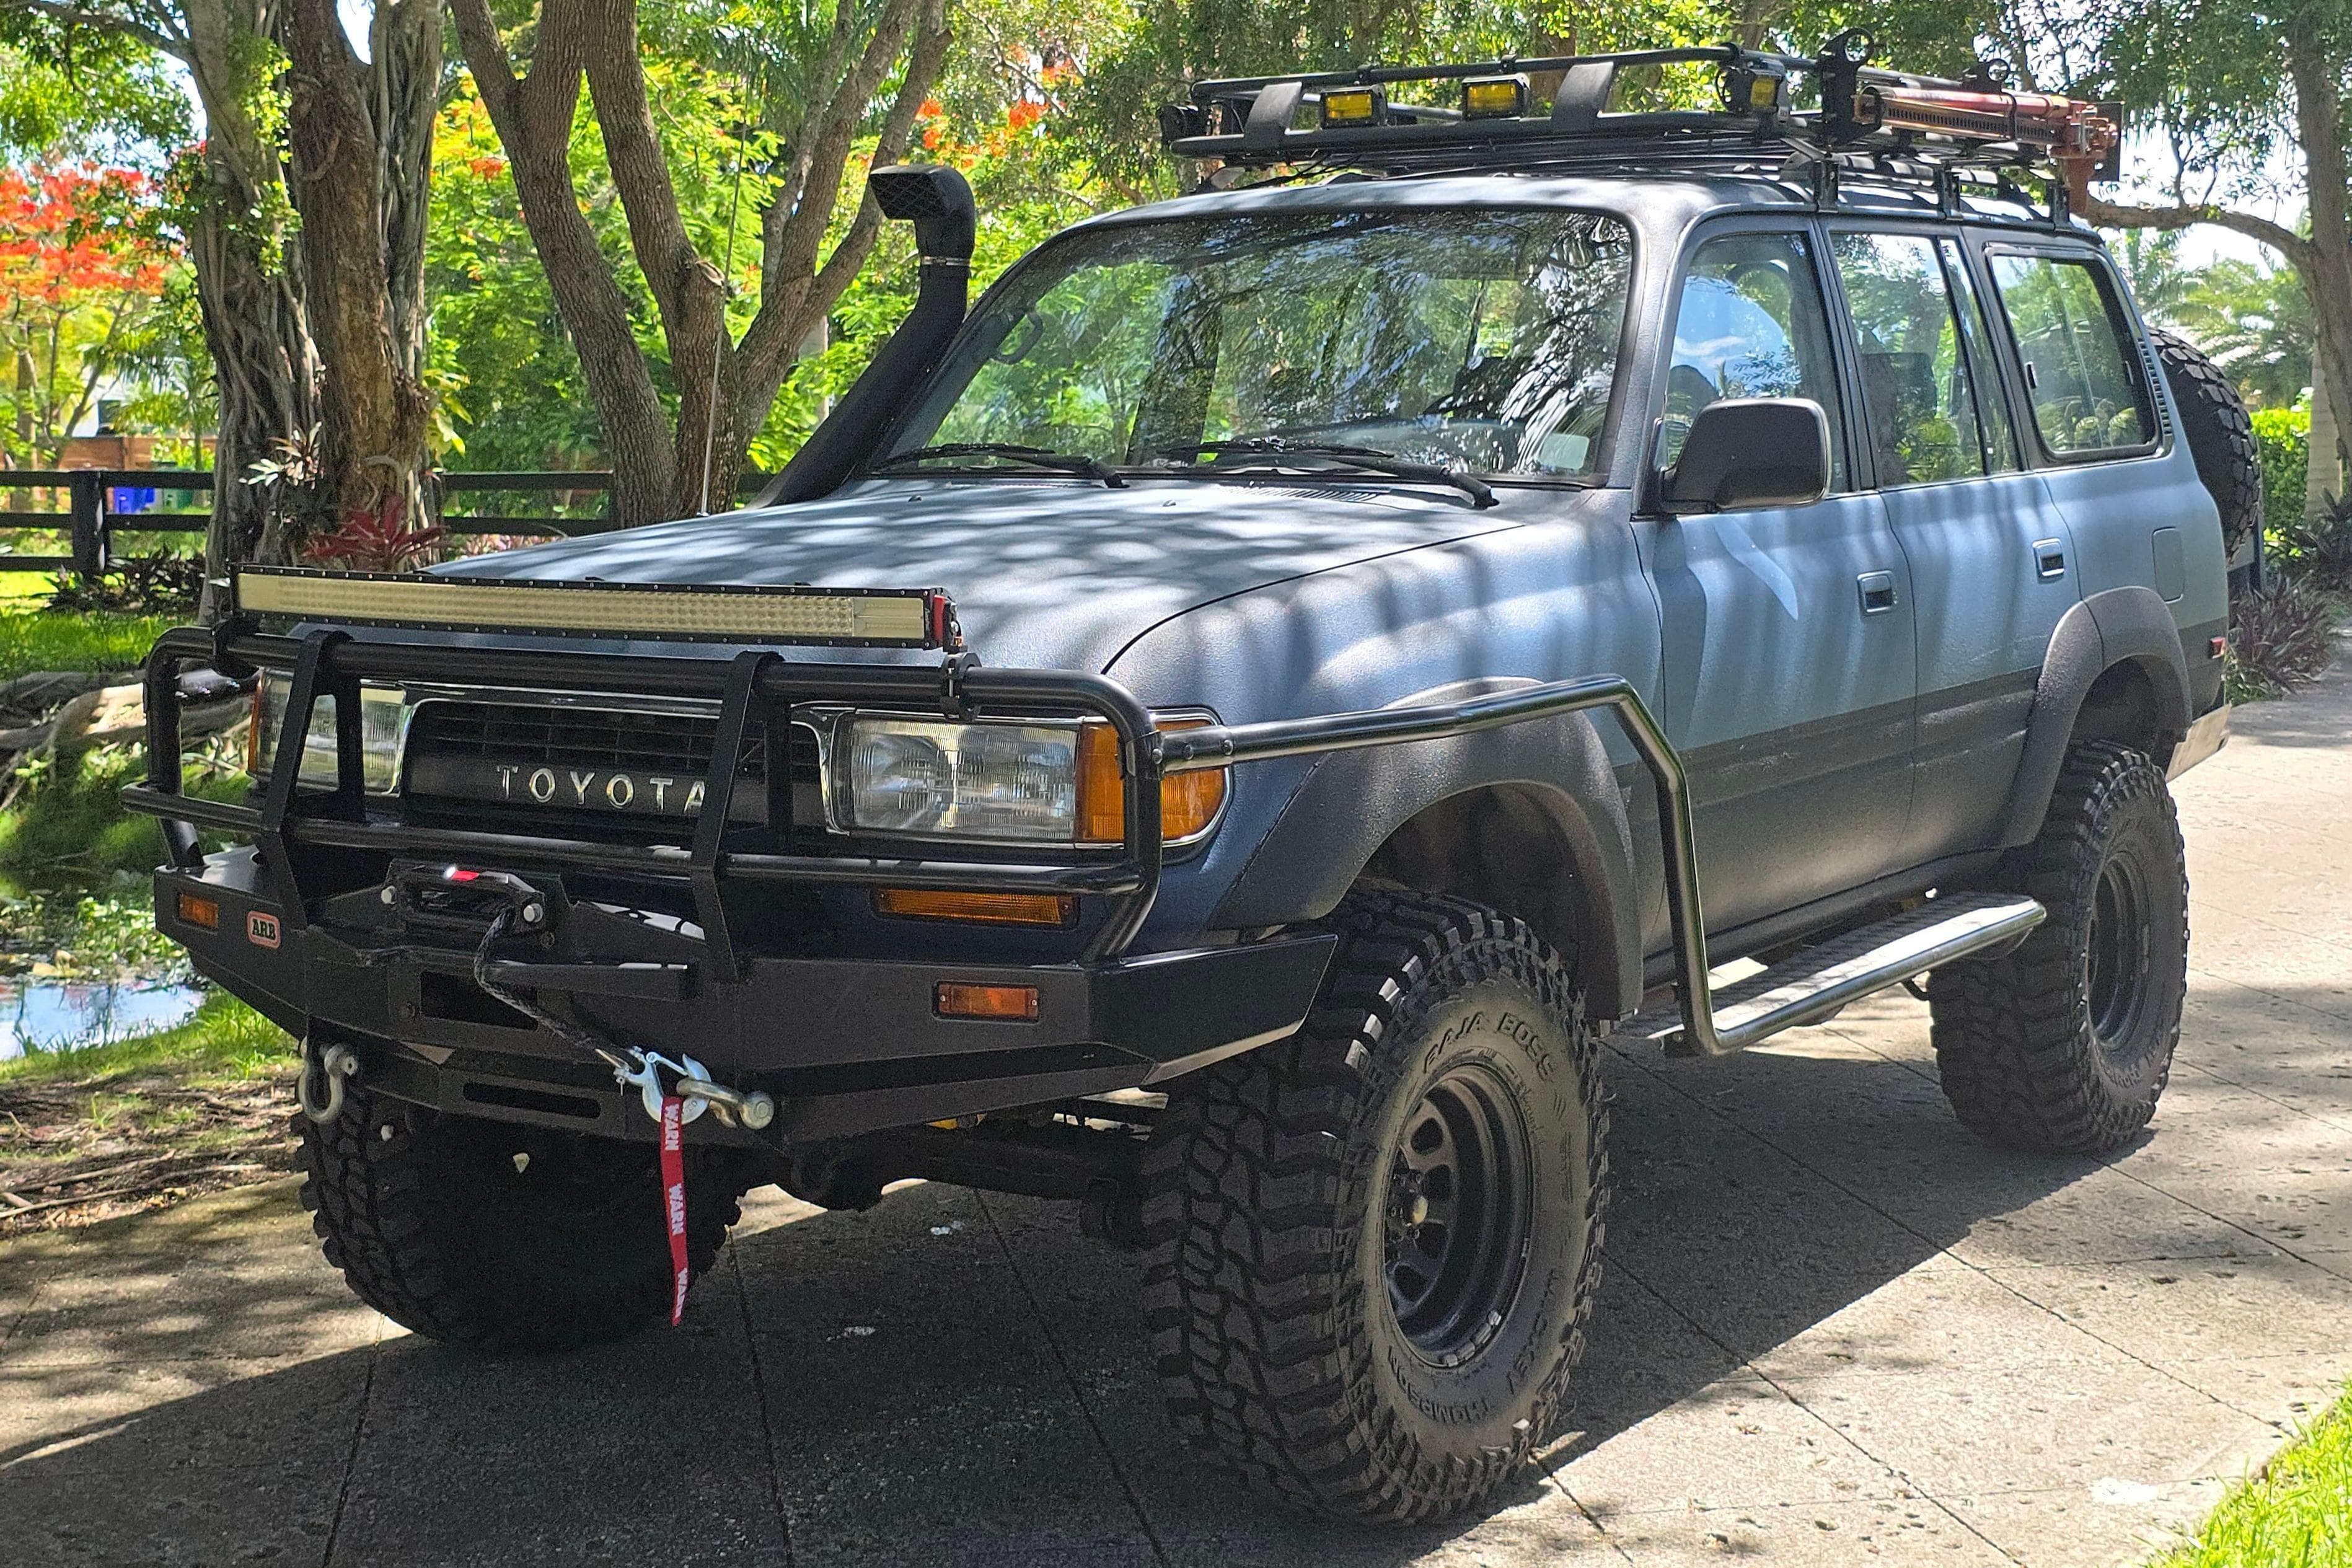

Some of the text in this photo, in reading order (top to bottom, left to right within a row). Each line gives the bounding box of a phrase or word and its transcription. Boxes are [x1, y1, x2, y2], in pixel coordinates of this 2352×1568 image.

[496, 766, 705, 813] TOYOTA
[252, 918, 277, 941] ARB
[664, 1103, 679, 1151] WARN
[669, 1183, 684, 1236] WARN
